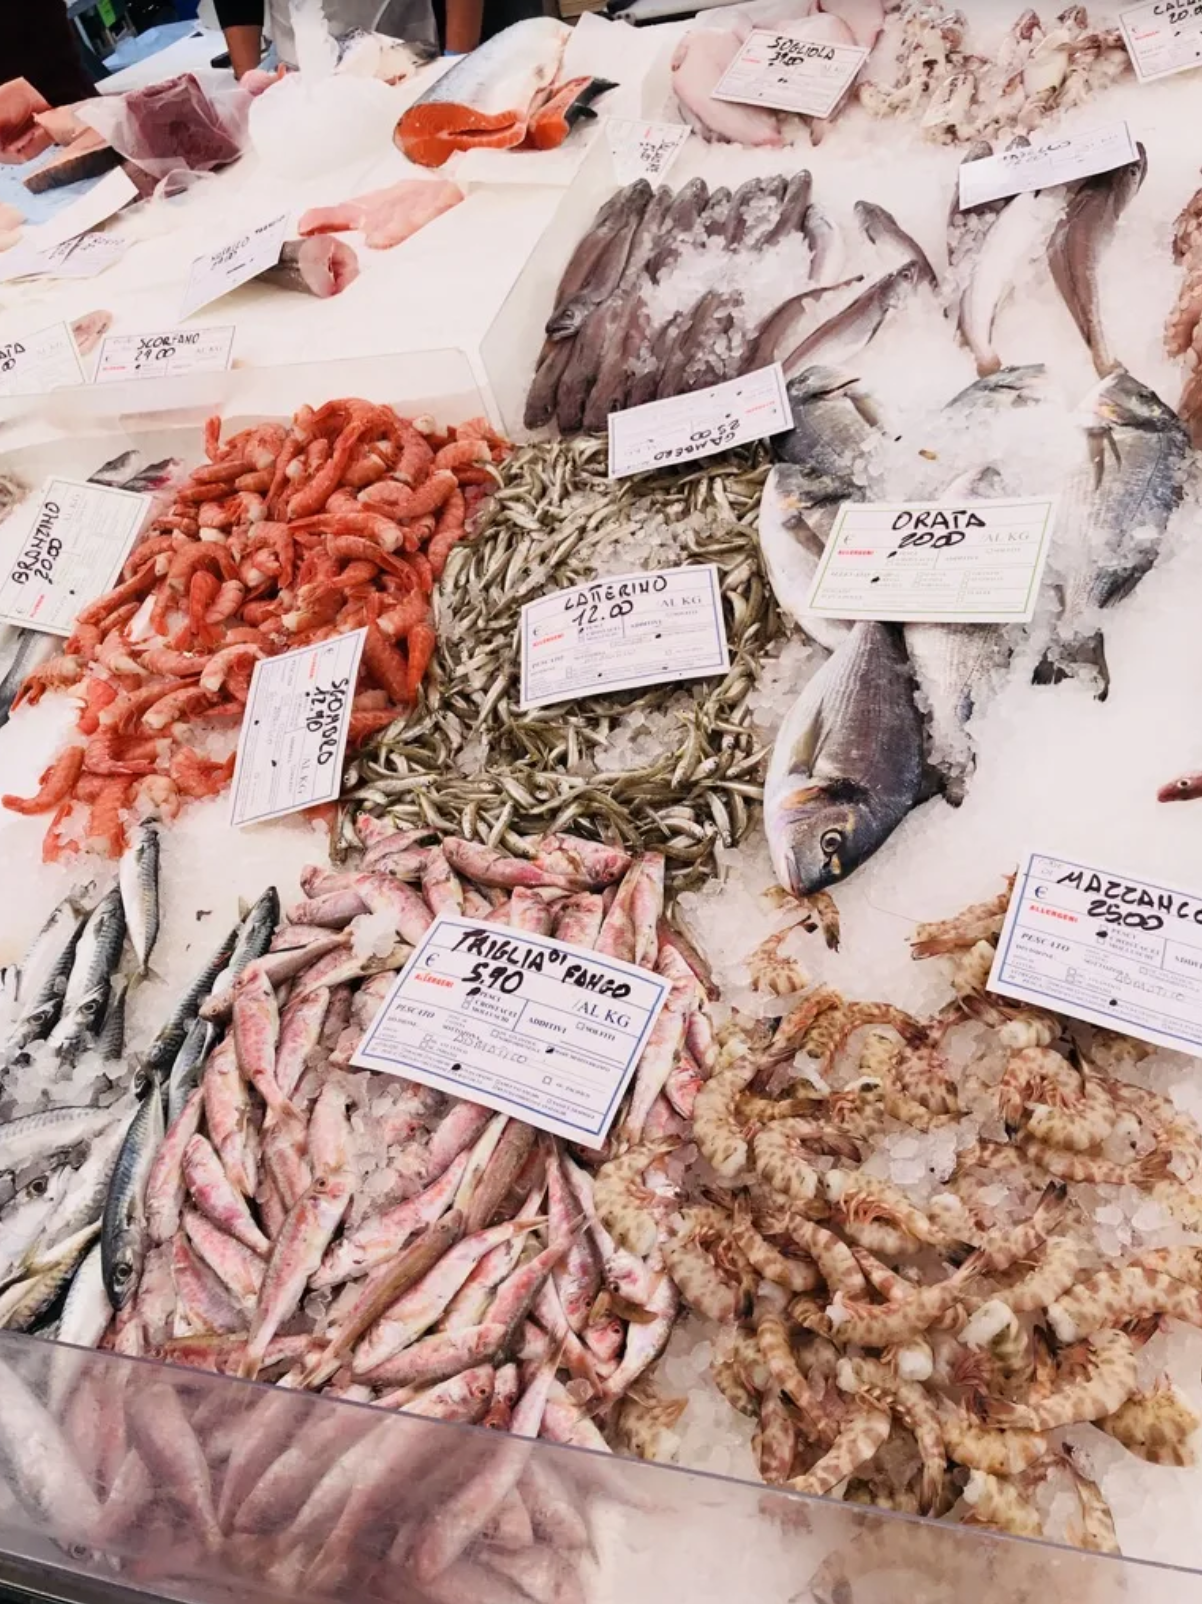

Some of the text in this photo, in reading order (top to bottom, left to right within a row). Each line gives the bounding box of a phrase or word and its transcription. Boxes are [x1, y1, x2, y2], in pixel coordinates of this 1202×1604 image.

[766, 36, 835, 61] SOGLIOLA
[653, 431, 736, 461] GAMBERO
[891, 509, 986, 530] ORATA
[12, 501, 61, 585] BRANZINO
[34, 538, 63, 580] 20.00
[564, 575, 668, 611] LATTERINO
[571, 599, 634, 627] 12.00
[317, 677, 349, 766] SGOMBRO
[1029, 904, 1078, 923] ALLERGENI
[1087, 900, 1164, 931] 25.00
[1021, 932, 1070, 952] PESCATO
[451, 928, 631, 998] TRIGLIA DI FANGO
[461, 962, 523, 994] 5.90
[604, 1009, 631, 1028] KG
[395, 1003, 435, 1019] PESCATO
[528, 1017, 567, 1034] ADDITIVI
